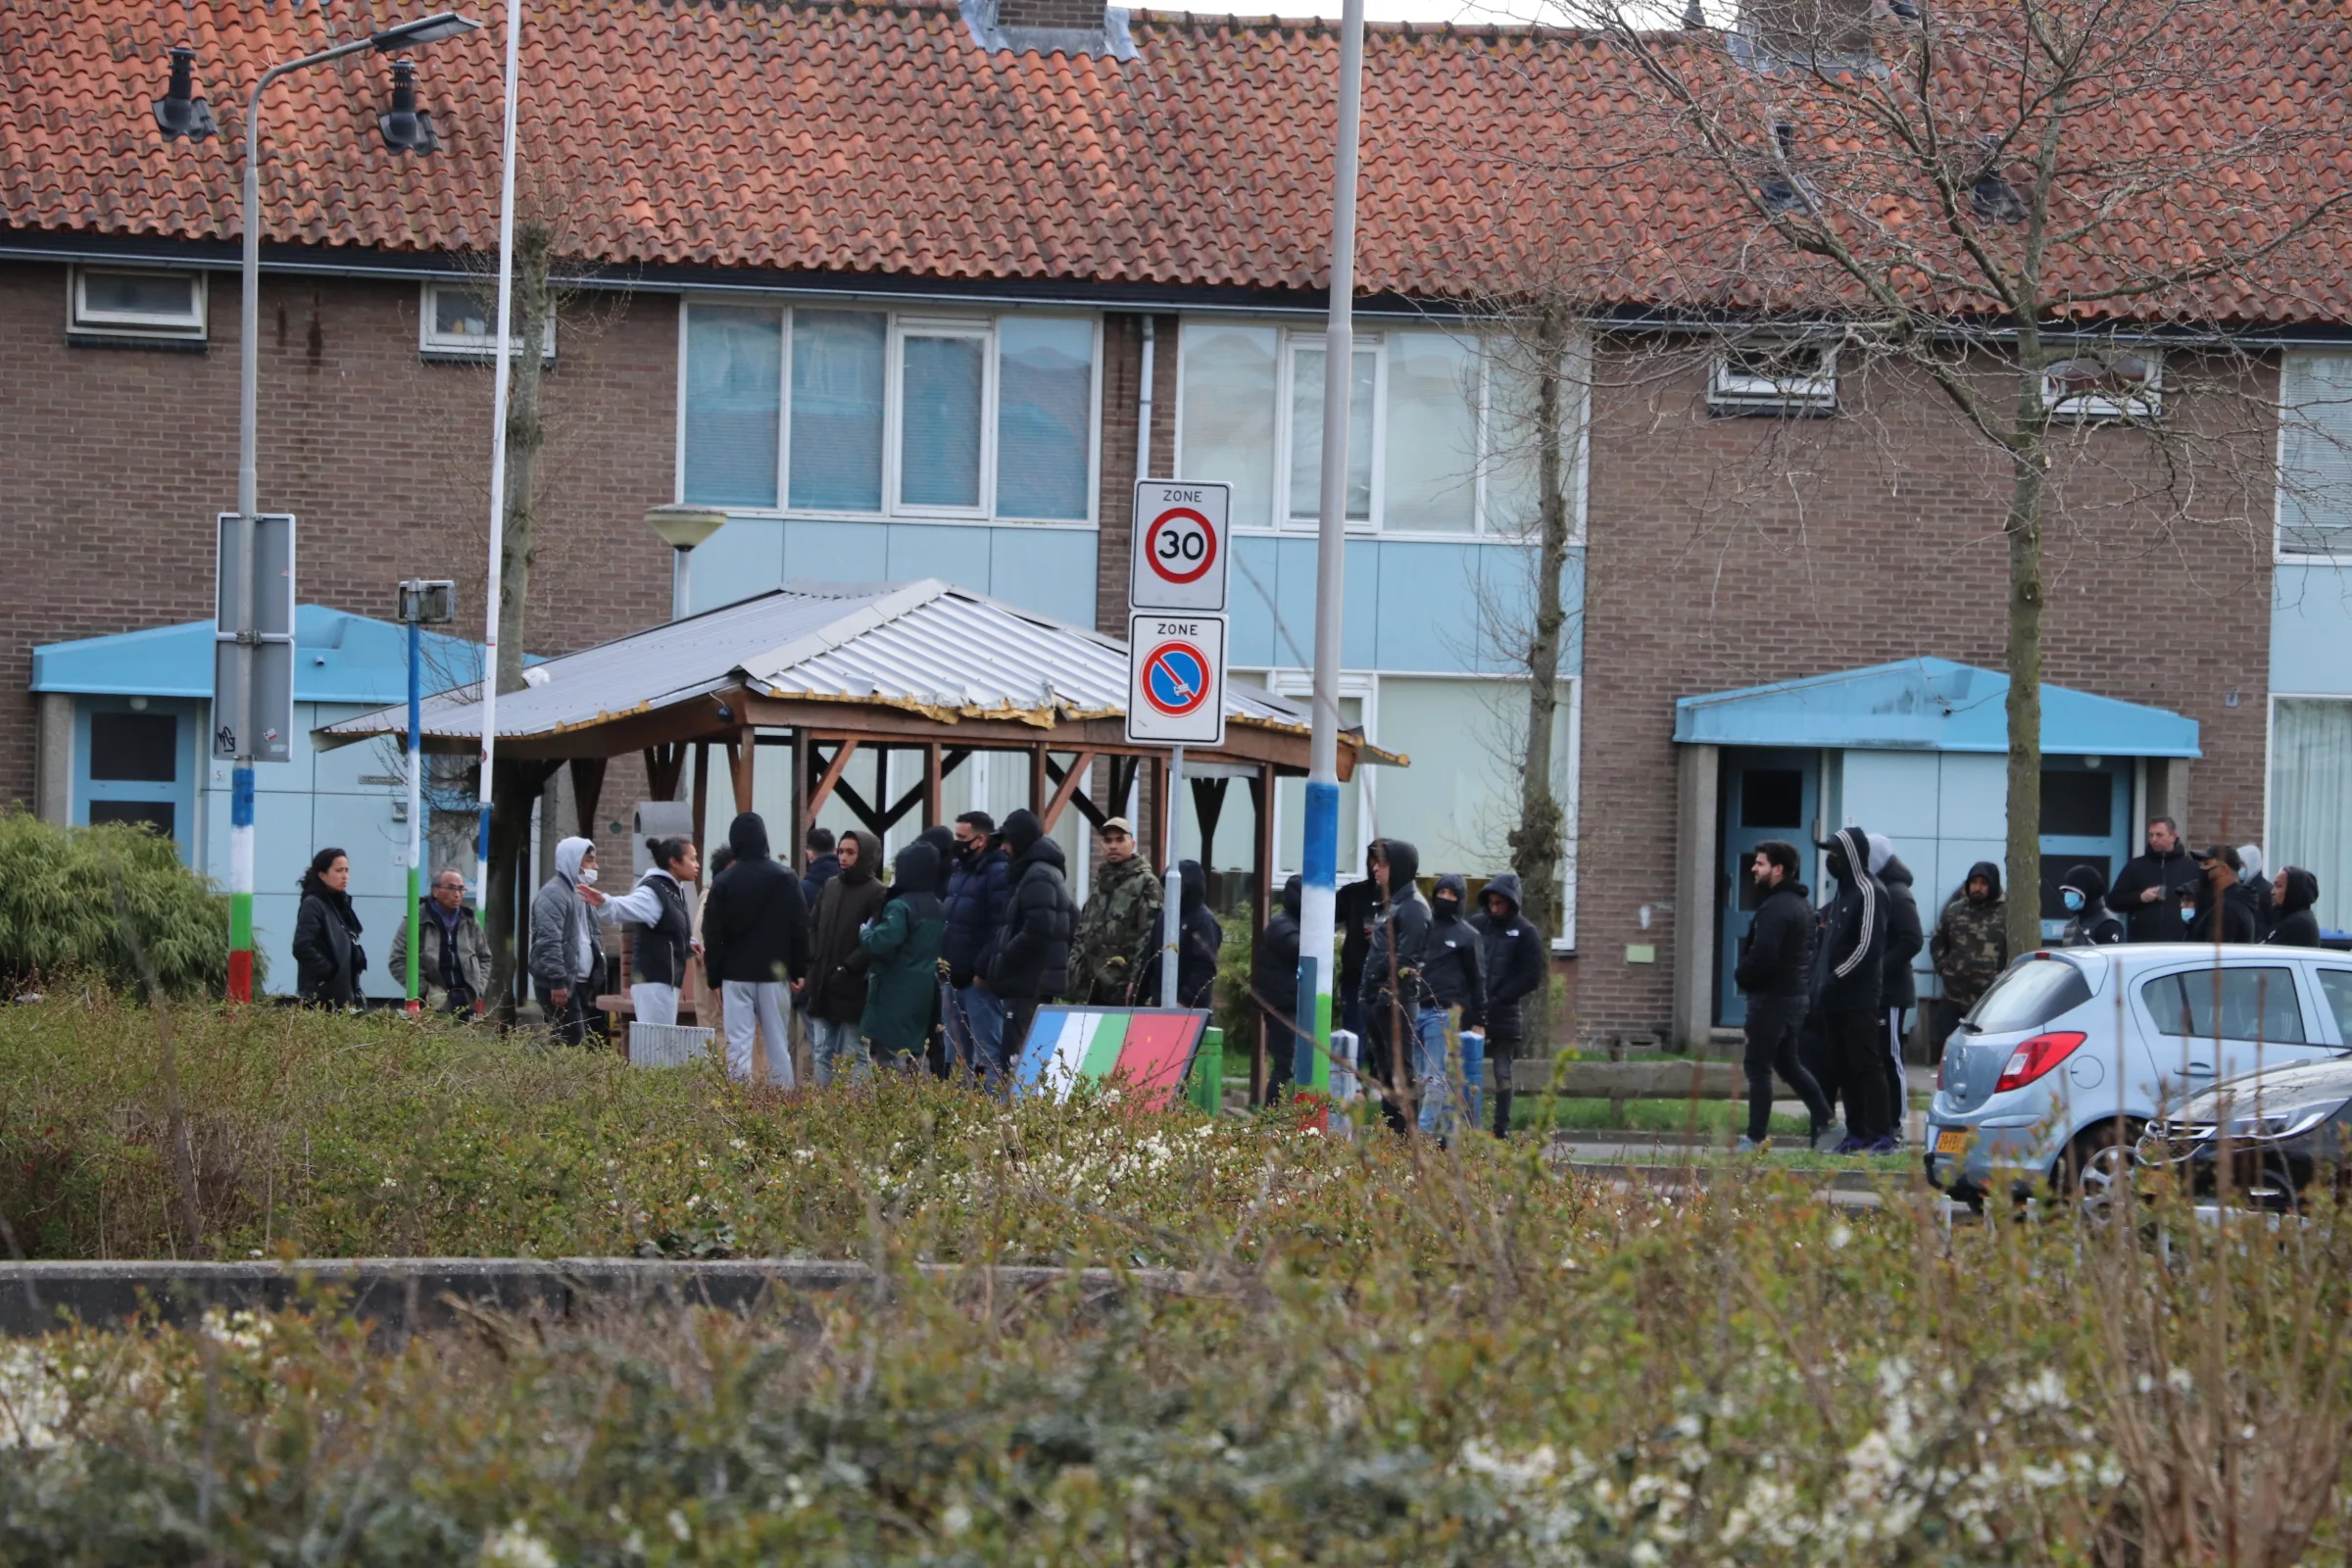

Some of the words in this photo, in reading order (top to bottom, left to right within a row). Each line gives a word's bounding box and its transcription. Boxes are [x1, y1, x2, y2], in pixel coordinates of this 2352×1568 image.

[1163, 490, 1201, 502] ZONE
[1158, 530, 1204, 561] 30
[1157, 623, 1198, 635] ZONE
[216, 770, 222, 780] 5
